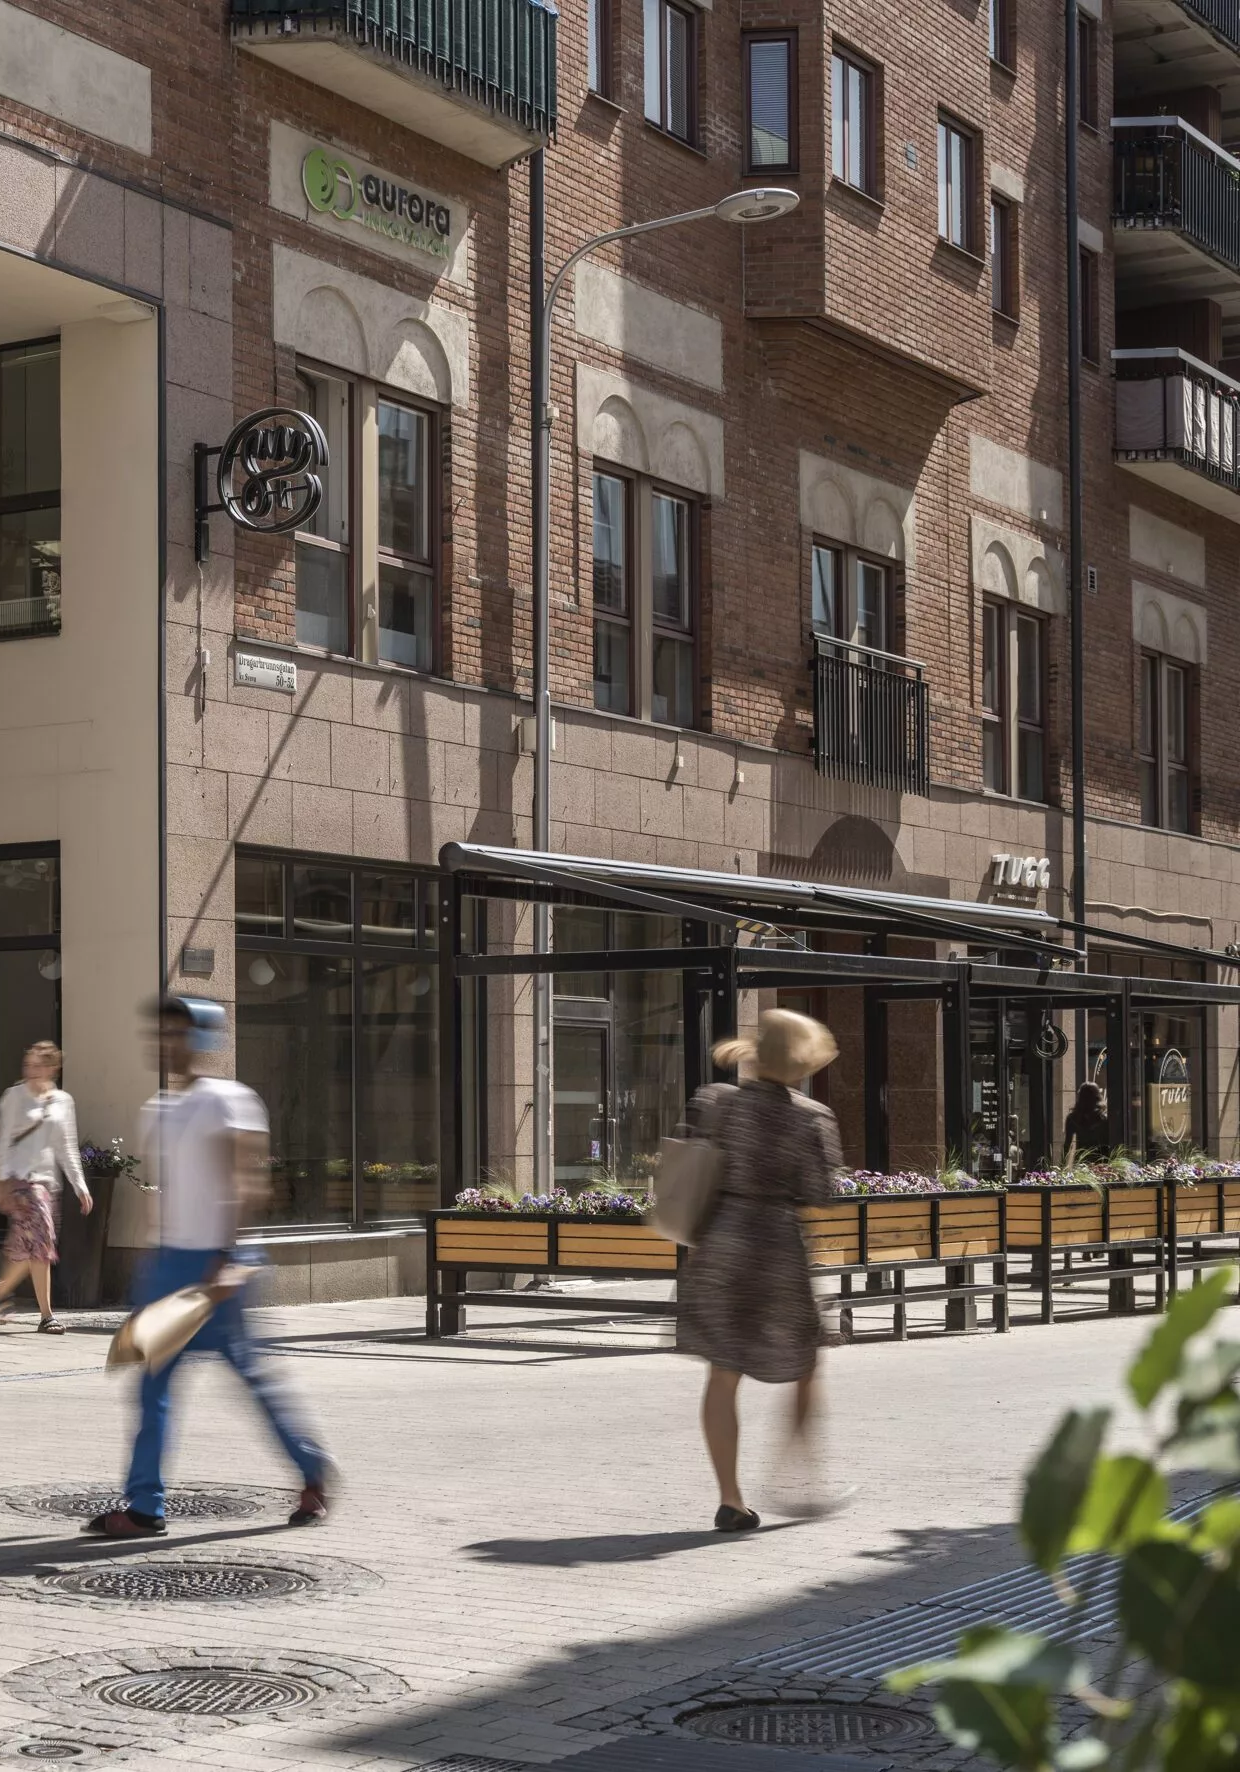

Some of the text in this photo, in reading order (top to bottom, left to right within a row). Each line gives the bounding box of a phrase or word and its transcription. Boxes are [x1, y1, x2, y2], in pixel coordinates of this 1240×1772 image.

[361, 174, 450, 236] aurora
[275, 675, 295, 689] 50-52
[991, 853, 1050, 889] TUGG
[1161, 1086, 1188, 1106] TUGG
